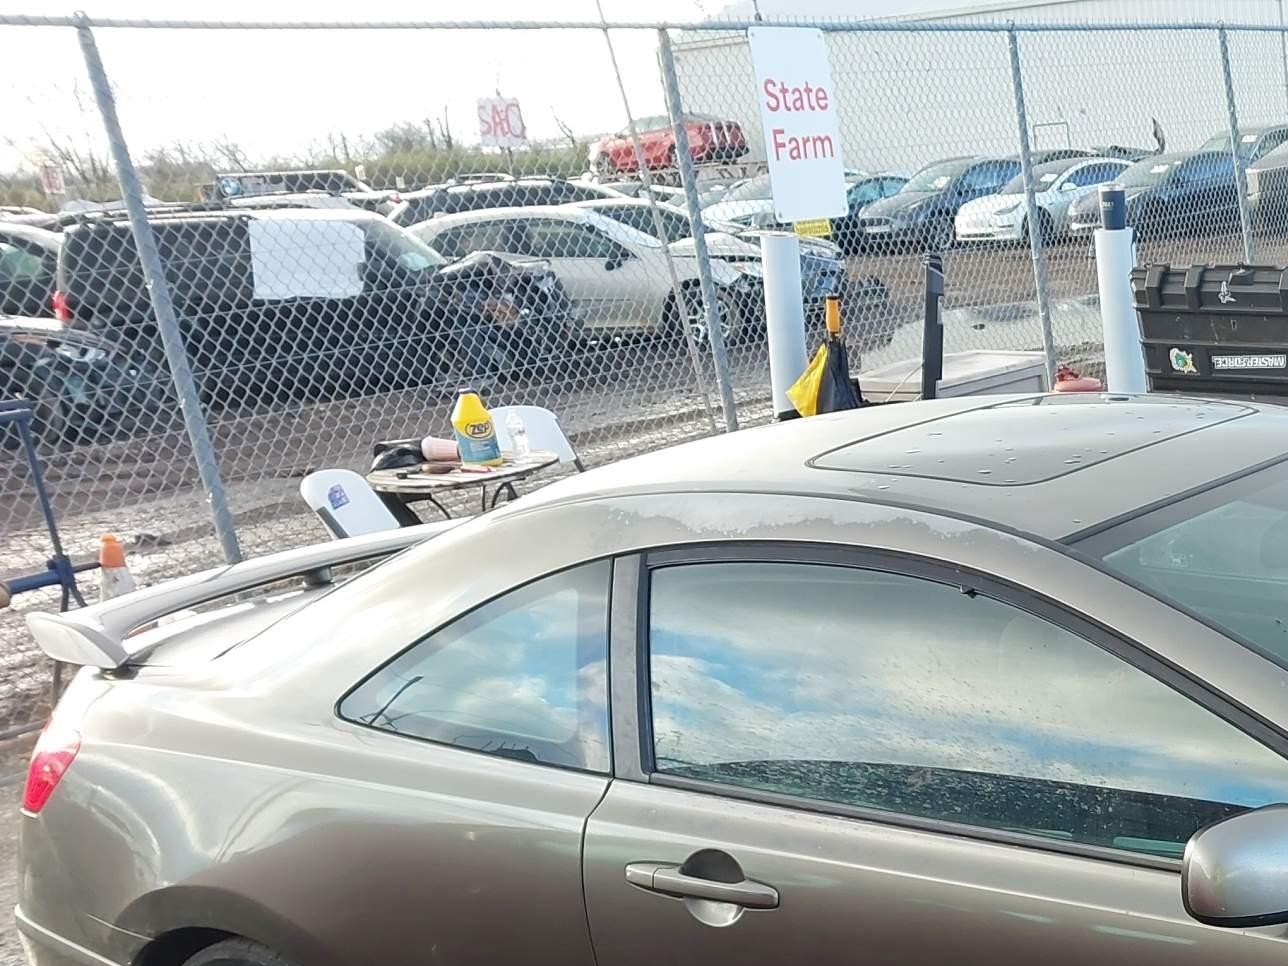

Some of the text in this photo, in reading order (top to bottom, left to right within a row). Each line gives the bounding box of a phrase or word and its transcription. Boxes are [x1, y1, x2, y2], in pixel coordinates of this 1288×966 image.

[763, 78, 829, 112] State
[772, 128, 834, 161] Farm
[1214, 356, 1286, 368] MASTERFORCE
